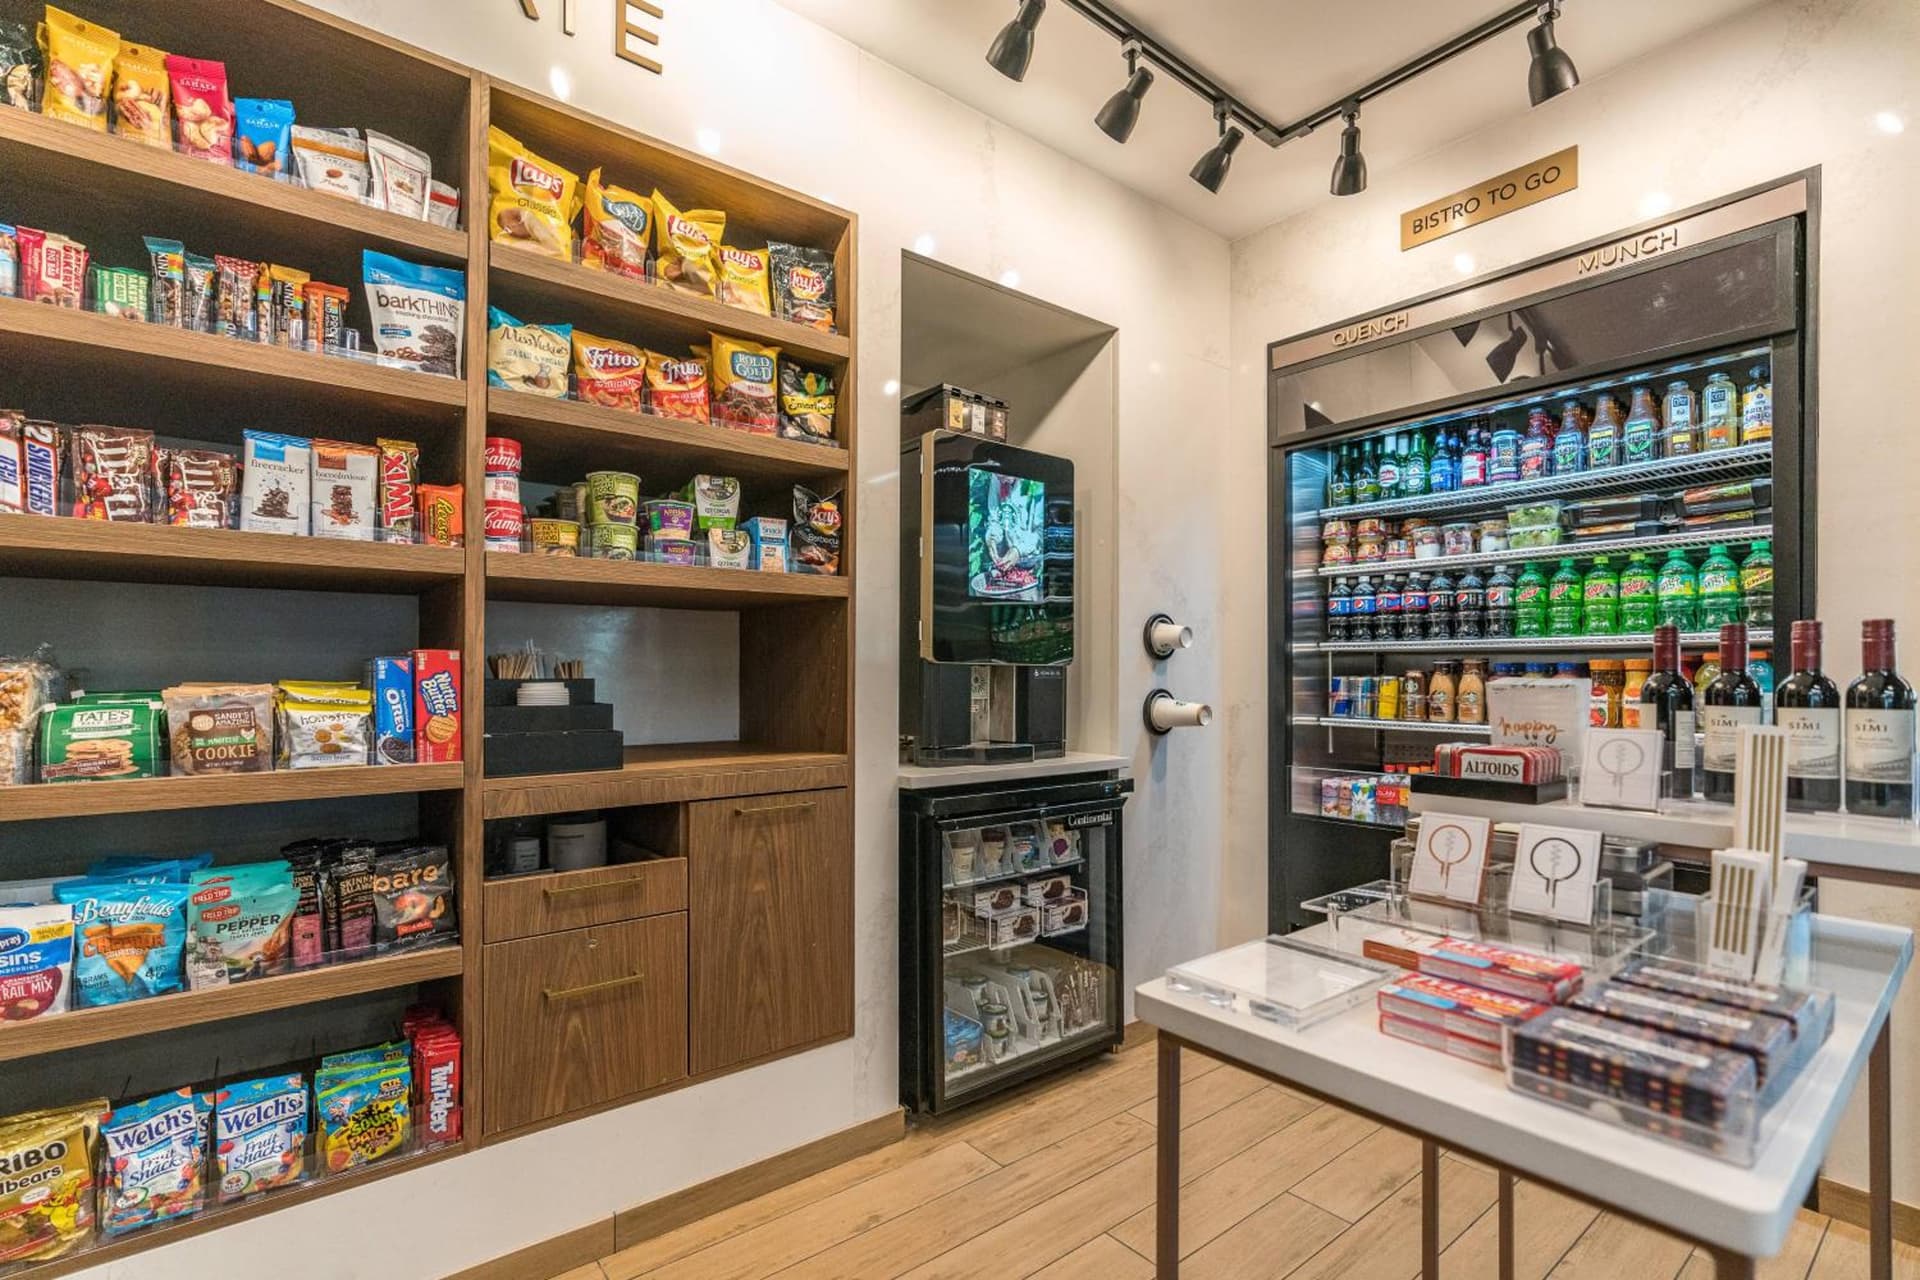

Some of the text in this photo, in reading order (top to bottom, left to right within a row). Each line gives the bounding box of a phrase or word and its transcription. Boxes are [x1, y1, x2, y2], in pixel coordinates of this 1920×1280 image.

[514, 159, 564, 194] Lay's
[1412, 165, 1561, 235] BISTRO TO GO
[1577, 227, 1678, 275] MUNCH
[157, 253, 168, 277] KIND
[283, 282, 295, 307] KIND
[1333, 311, 1409, 346] QUENCH
[585, 348, 641, 369] Fritos
[735, 352, 770, 368] ROLD
[734, 363, 773, 379] GOLD
[251, 458, 306, 475] firecracker
[27, 442, 54, 517] SNICKERS
[383, 451, 416, 528] TWIX
[809, 508, 841, 525] Lay's
[421, 679, 448, 717] Butter
[434, 672, 458, 712] Nutter
[76, 710, 132, 722] TATE'S
[386, 688, 405, 733] OREO
[1710, 719, 1739, 728] SIMI
[1788, 721, 1821, 731] SIMI
[1854, 723, 1889, 733] SIMI
[195, 744, 256, 761] COOKIE
[1464, 759, 1520, 777] ALTOIDS
[1067, 811, 1112, 826] Continental
[374, 864, 439, 893] bare
[74, 896, 175, 924] Beanfields
[216, 914, 281, 934] PEPPER
[31, 979, 53, 995] MIX
[222, 1097, 298, 1134] Welch's
[350, 1112, 394, 1136] SOUR
[112, 1108, 193, 1151] Welch's
[347, 1119, 398, 1149] PATCH
[245, 1133, 278, 1153] Fruit
[140, 1148, 176, 1171] Fruit
[234, 1142, 285, 1170] Snacks
